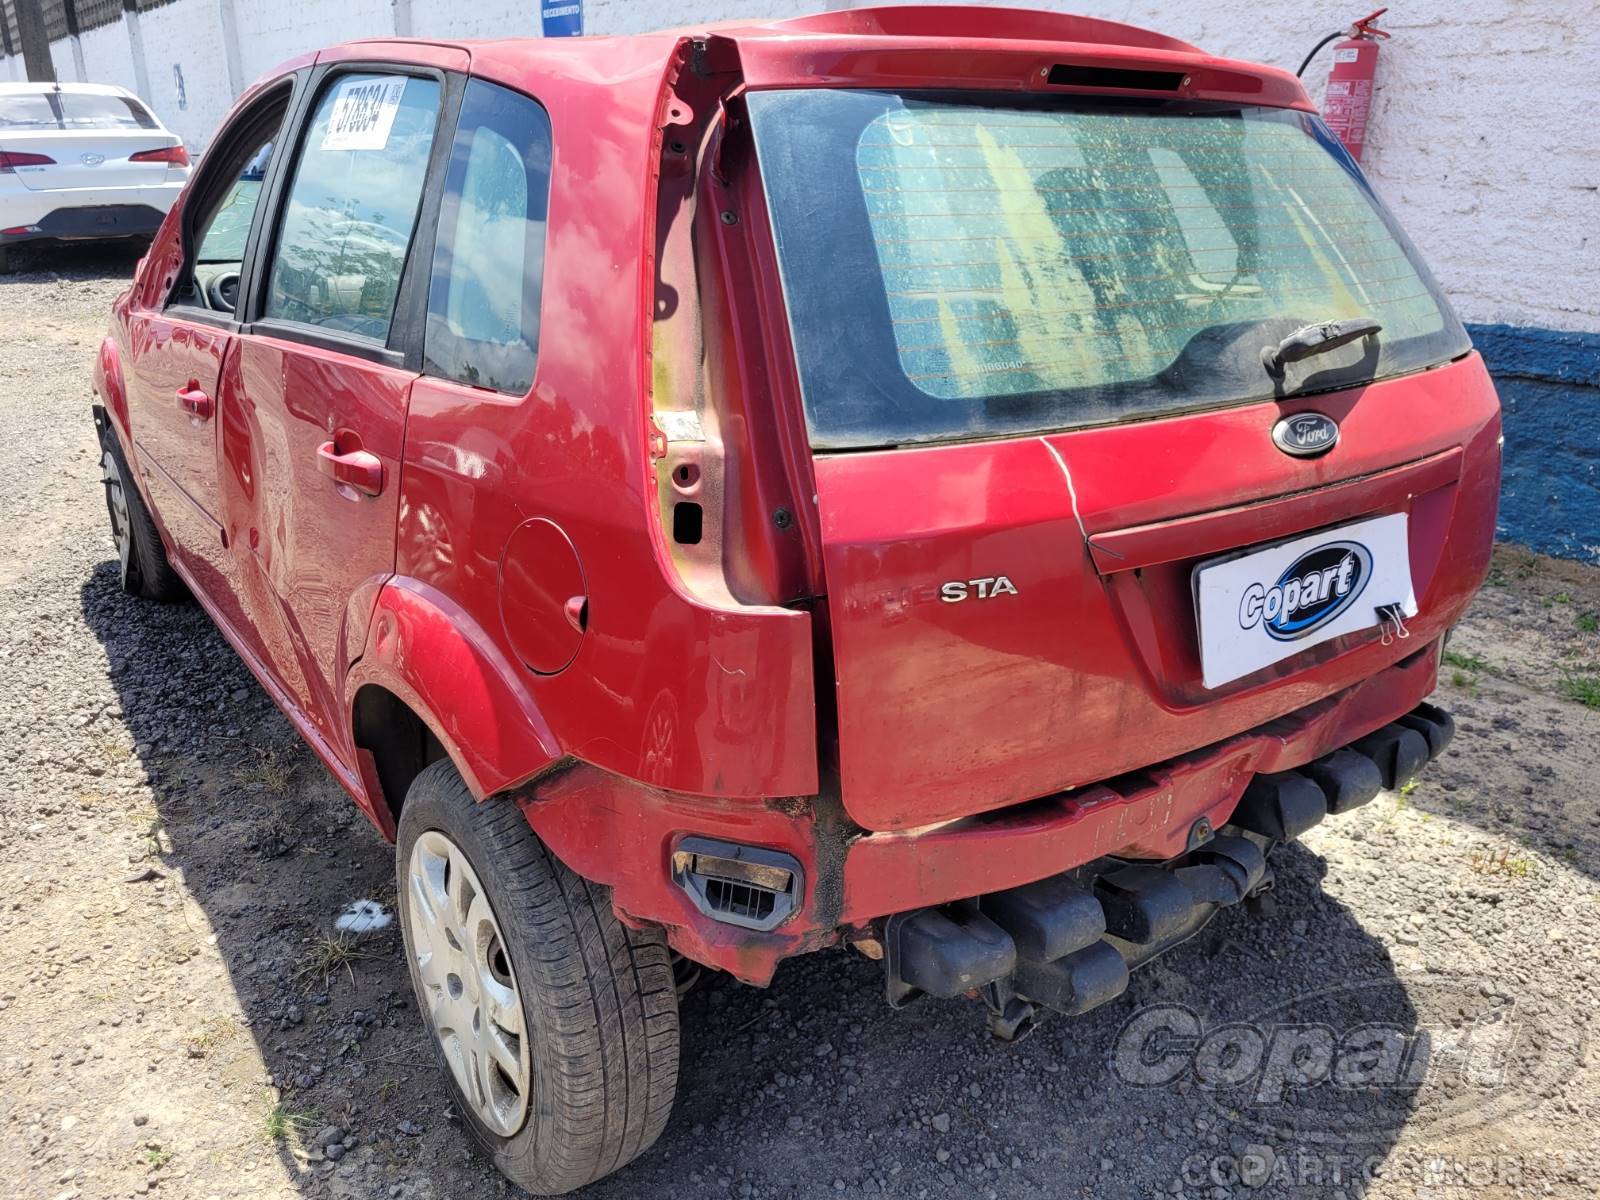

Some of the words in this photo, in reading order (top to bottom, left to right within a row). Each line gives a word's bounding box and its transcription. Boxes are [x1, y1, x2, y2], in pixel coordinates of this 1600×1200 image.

[335, 83, 389, 133] 578634
[1296, 419, 1330, 445] Ford
[1239, 550, 1356, 630] Copart
